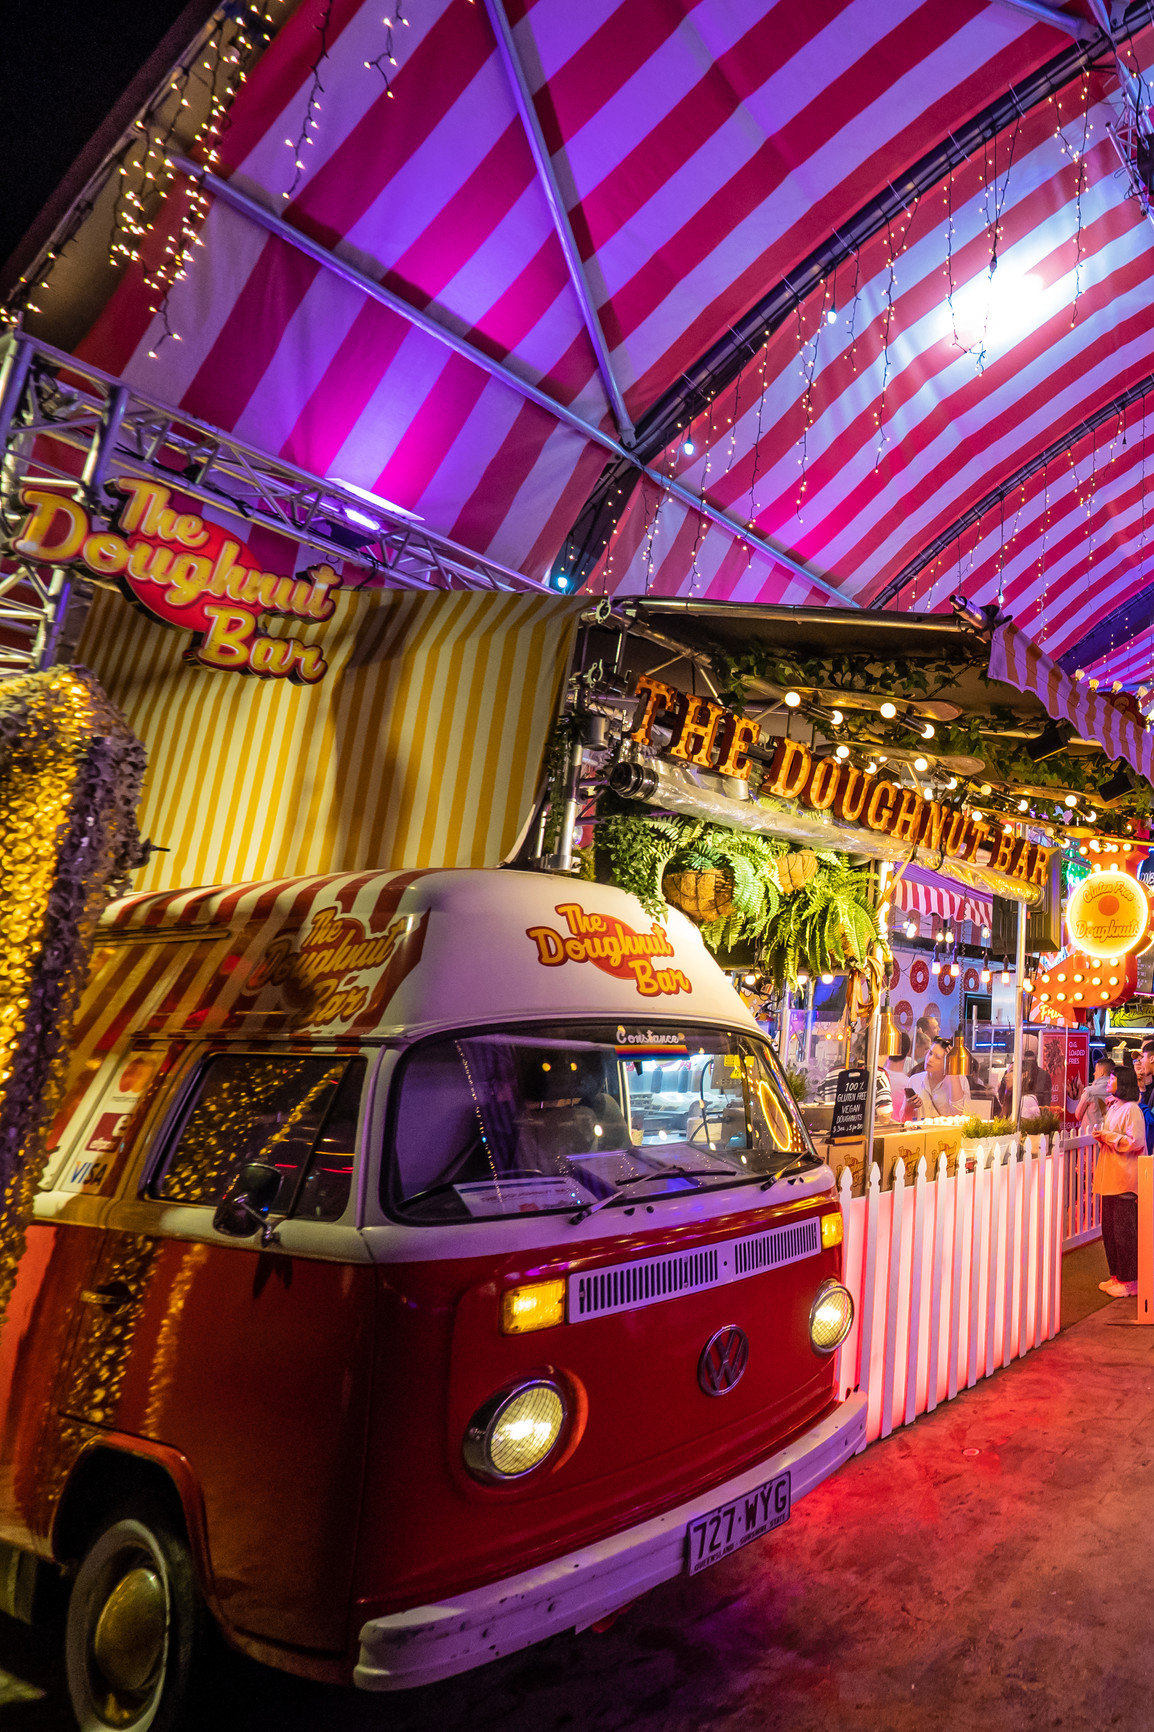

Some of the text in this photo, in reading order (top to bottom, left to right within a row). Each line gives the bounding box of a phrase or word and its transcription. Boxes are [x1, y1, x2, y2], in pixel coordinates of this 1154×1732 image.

[115, 476, 210, 547] The
[12, 489, 343, 622] Doughnut
[197, 604, 328, 685] Bar
[633, 674, 1050, 887] THE DOUGHNUT BAR
[1083, 880, 1135, 903] Gluten Free
[301, 905, 345, 948] The
[555, 902, 608, 936] The
[1075, 918, 1139, 944] Doughnuts
[246, 915, 410, 990] Doughnut
[526, 922, 674, 968] Doughnut
[628, 958, 693, 998] Bar
[304, 977, 370, 1027] Bar
[616, 1027, 680, 1045] Constance
[1068, 1049, 1086, 1057] LOADED
[841, 1104, 861, 1114] VEGAN
[70, 1161, 108, 1186] VISA
